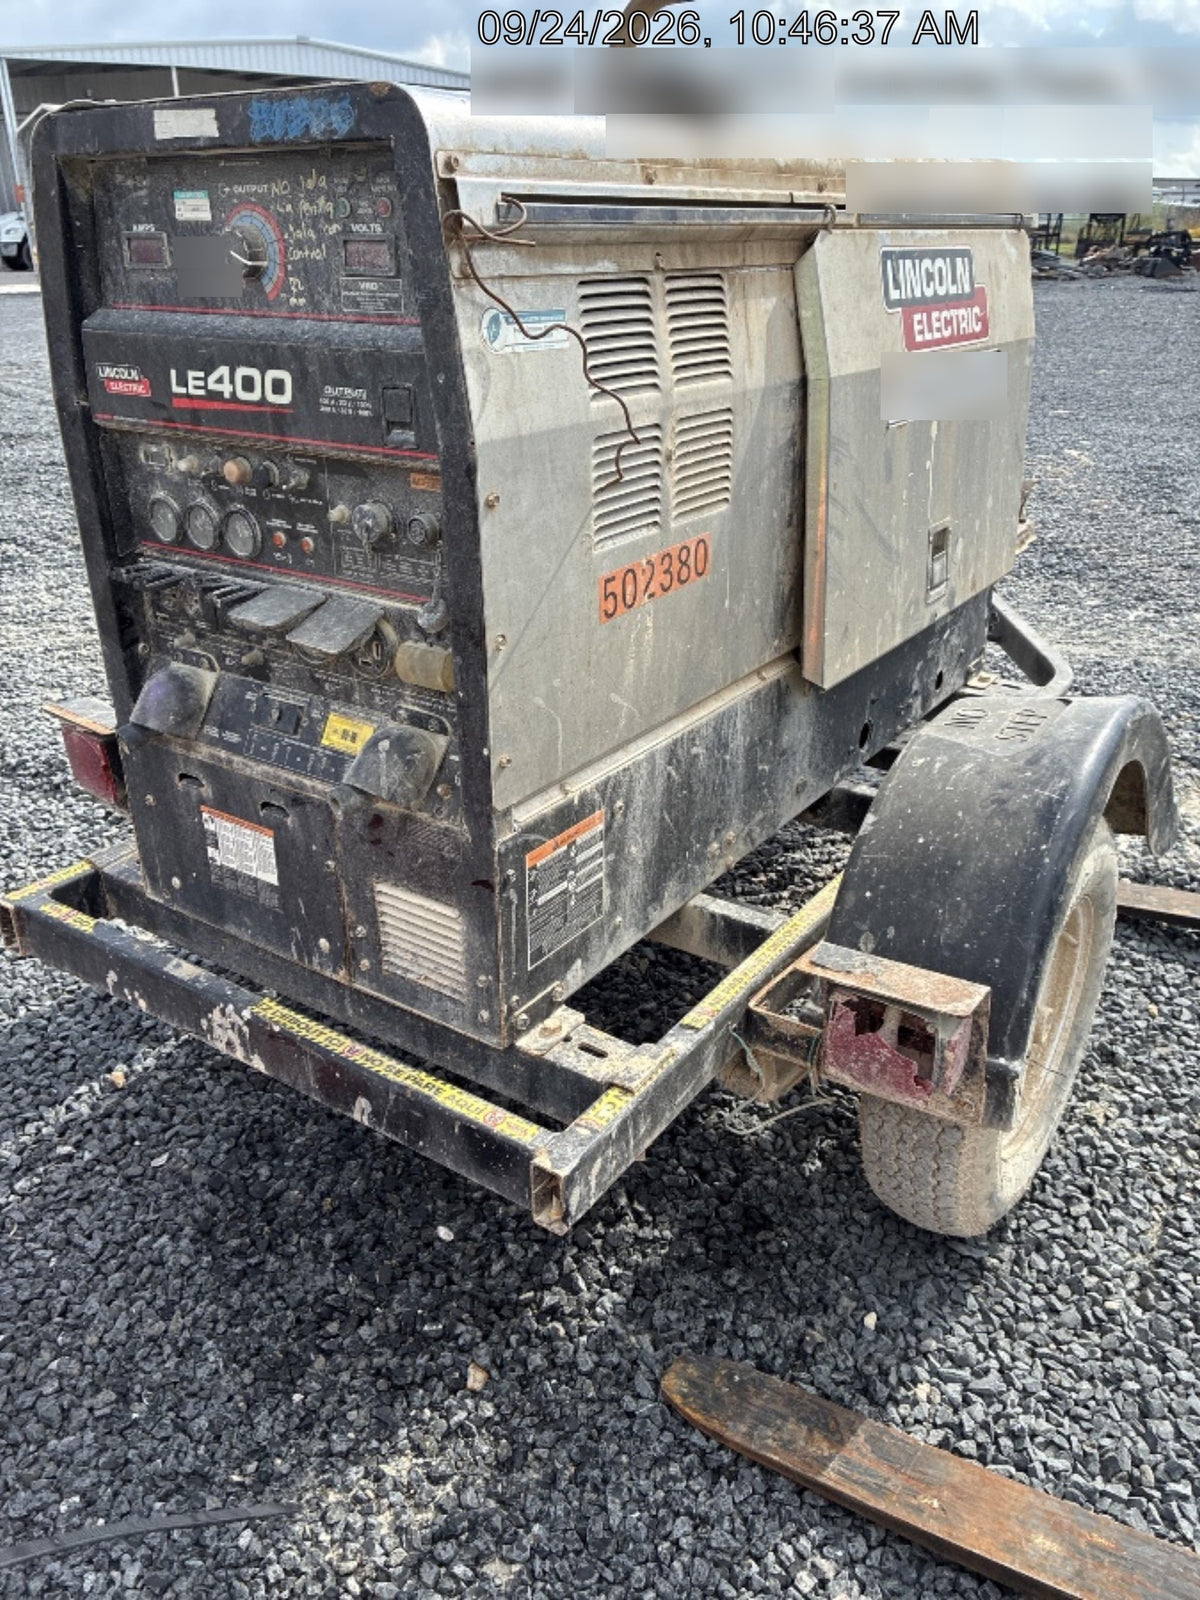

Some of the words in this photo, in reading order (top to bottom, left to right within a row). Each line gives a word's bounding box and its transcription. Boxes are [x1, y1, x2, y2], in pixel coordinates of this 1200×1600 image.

[233, 184, 268, 193] OUTPUT
[350, 223, 383, 232] VOLTS
[886, 257, 971, 300] LINCOLN
[913, 305, 983, 342] ELECTRIC
[170, 365, 293, 405] LE400
[603, 538, 709, 619] 502380
